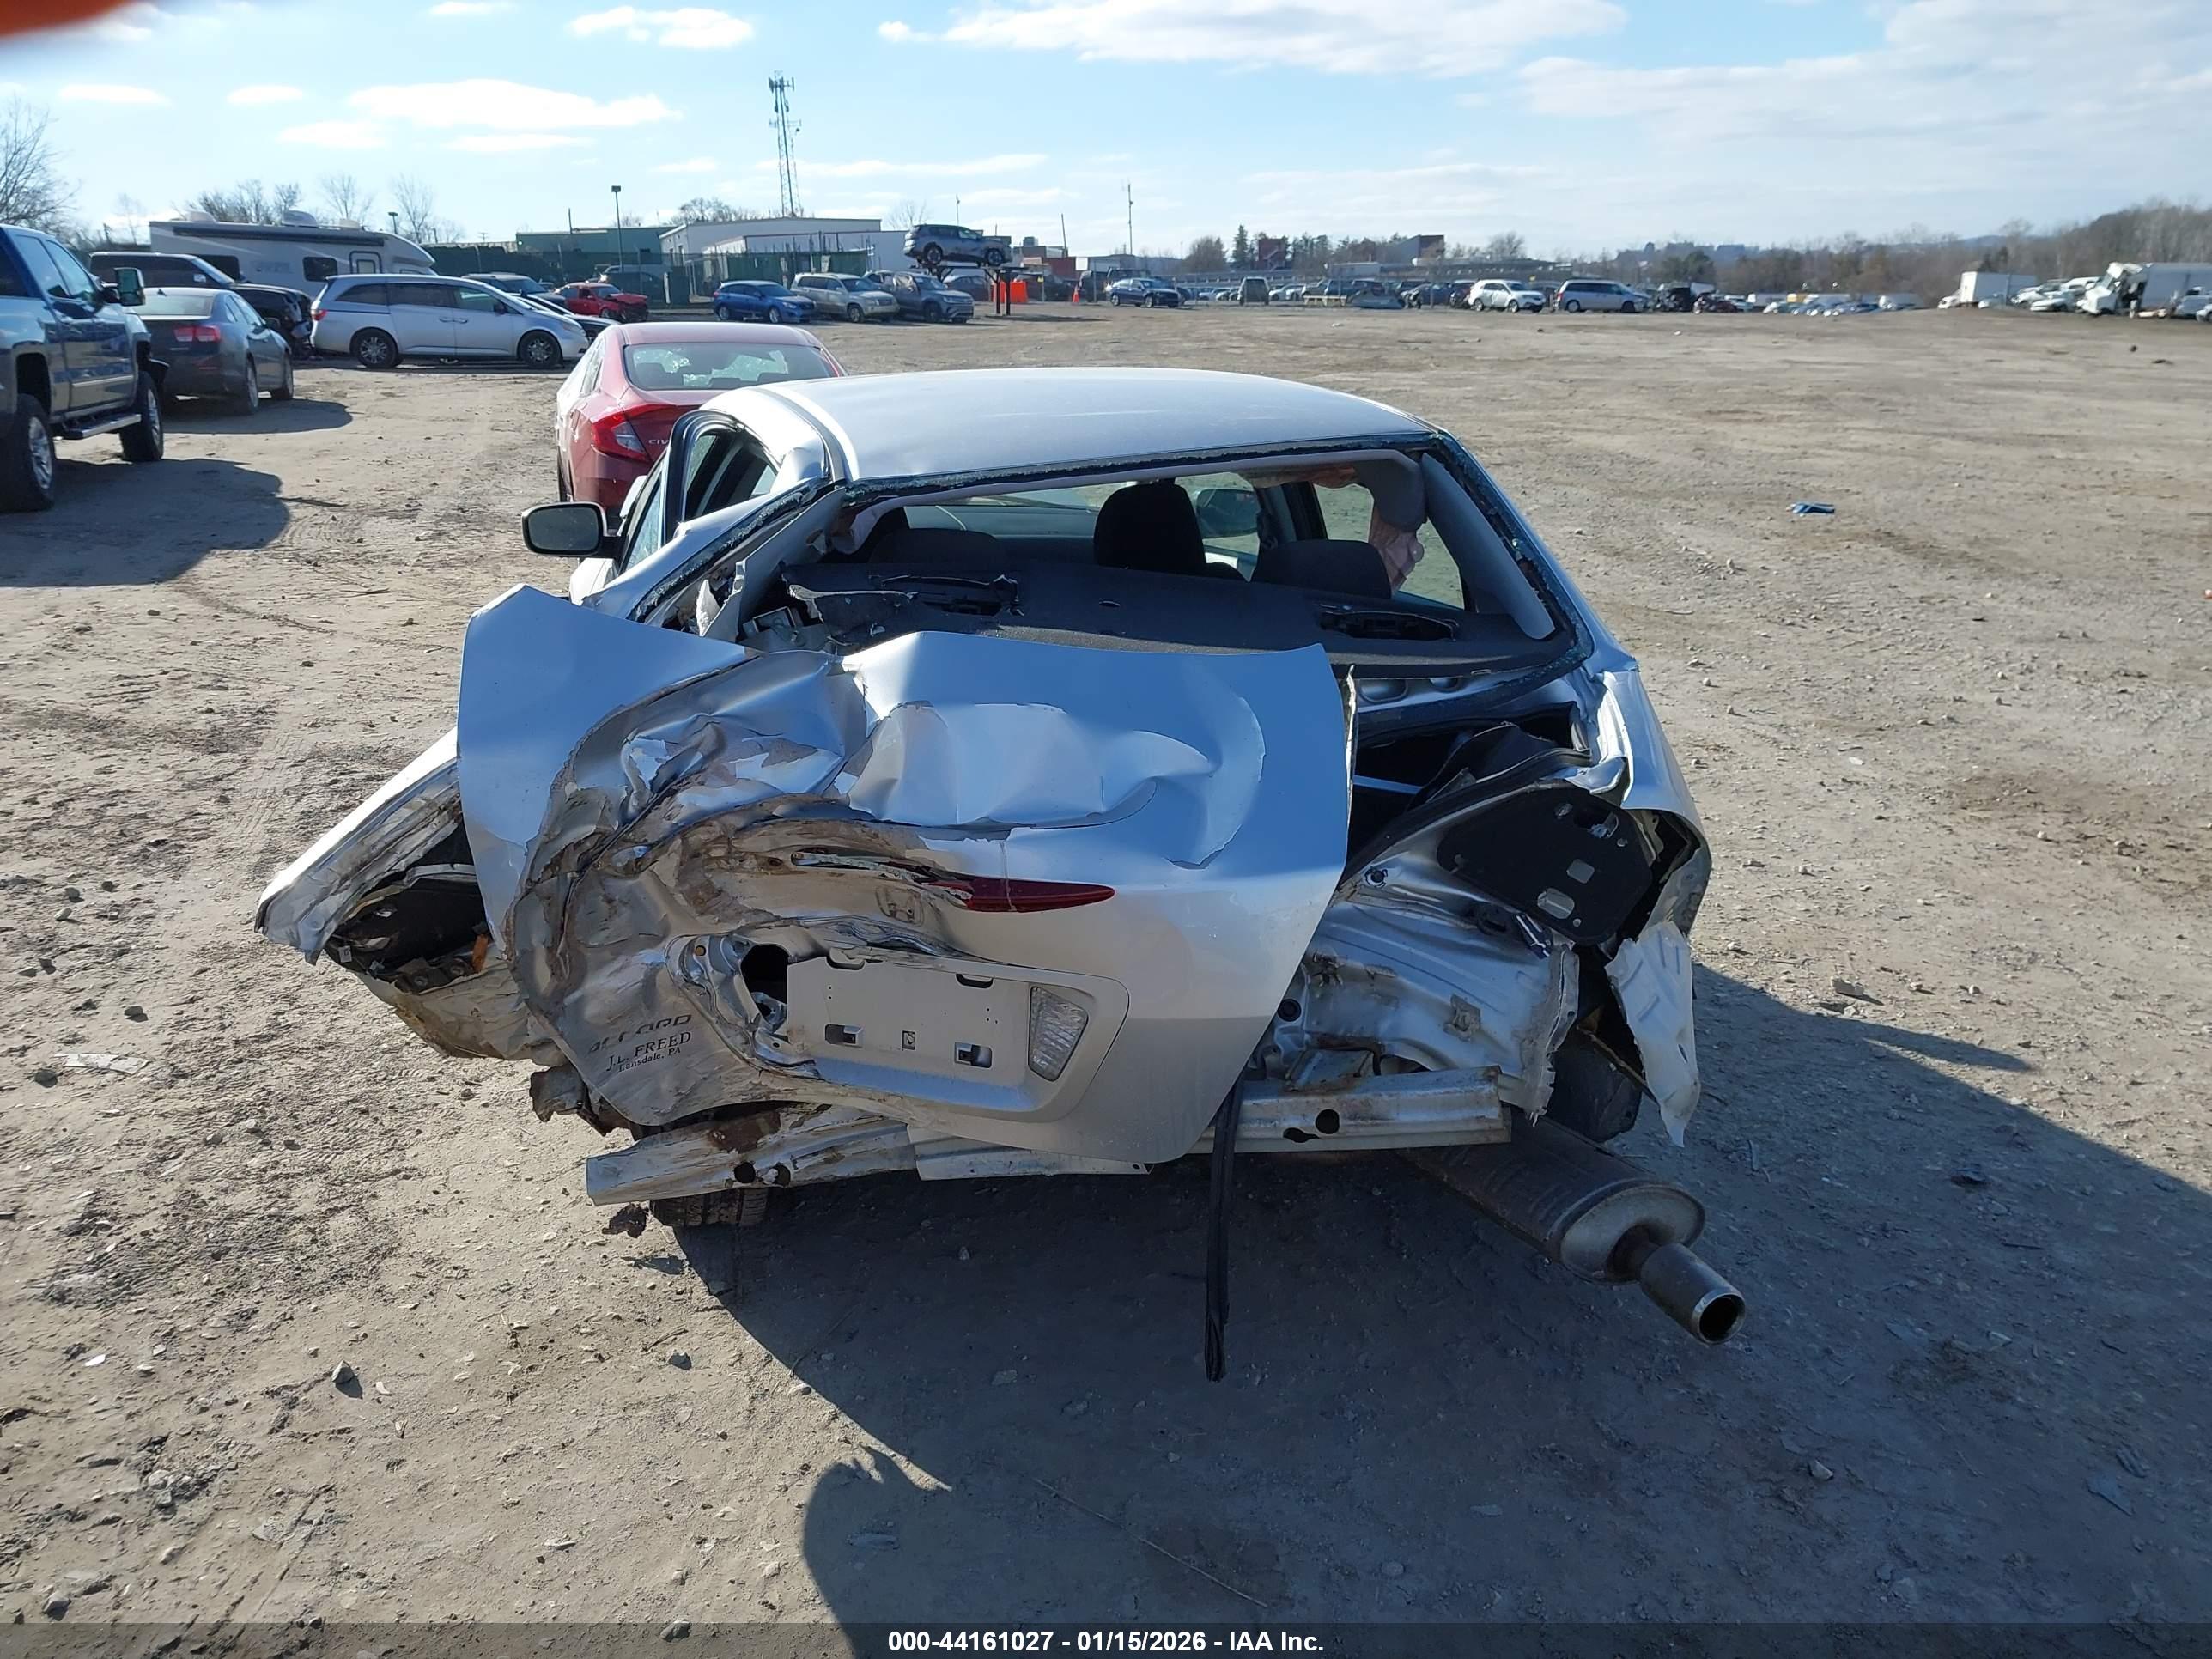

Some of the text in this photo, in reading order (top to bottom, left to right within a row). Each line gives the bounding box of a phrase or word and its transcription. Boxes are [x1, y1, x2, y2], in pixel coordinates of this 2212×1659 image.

[588, 1014, 692, 1053] ACCORD
[634, 1031, 691, 1057] FREED
[668, 1046, 681, 1056] PA
